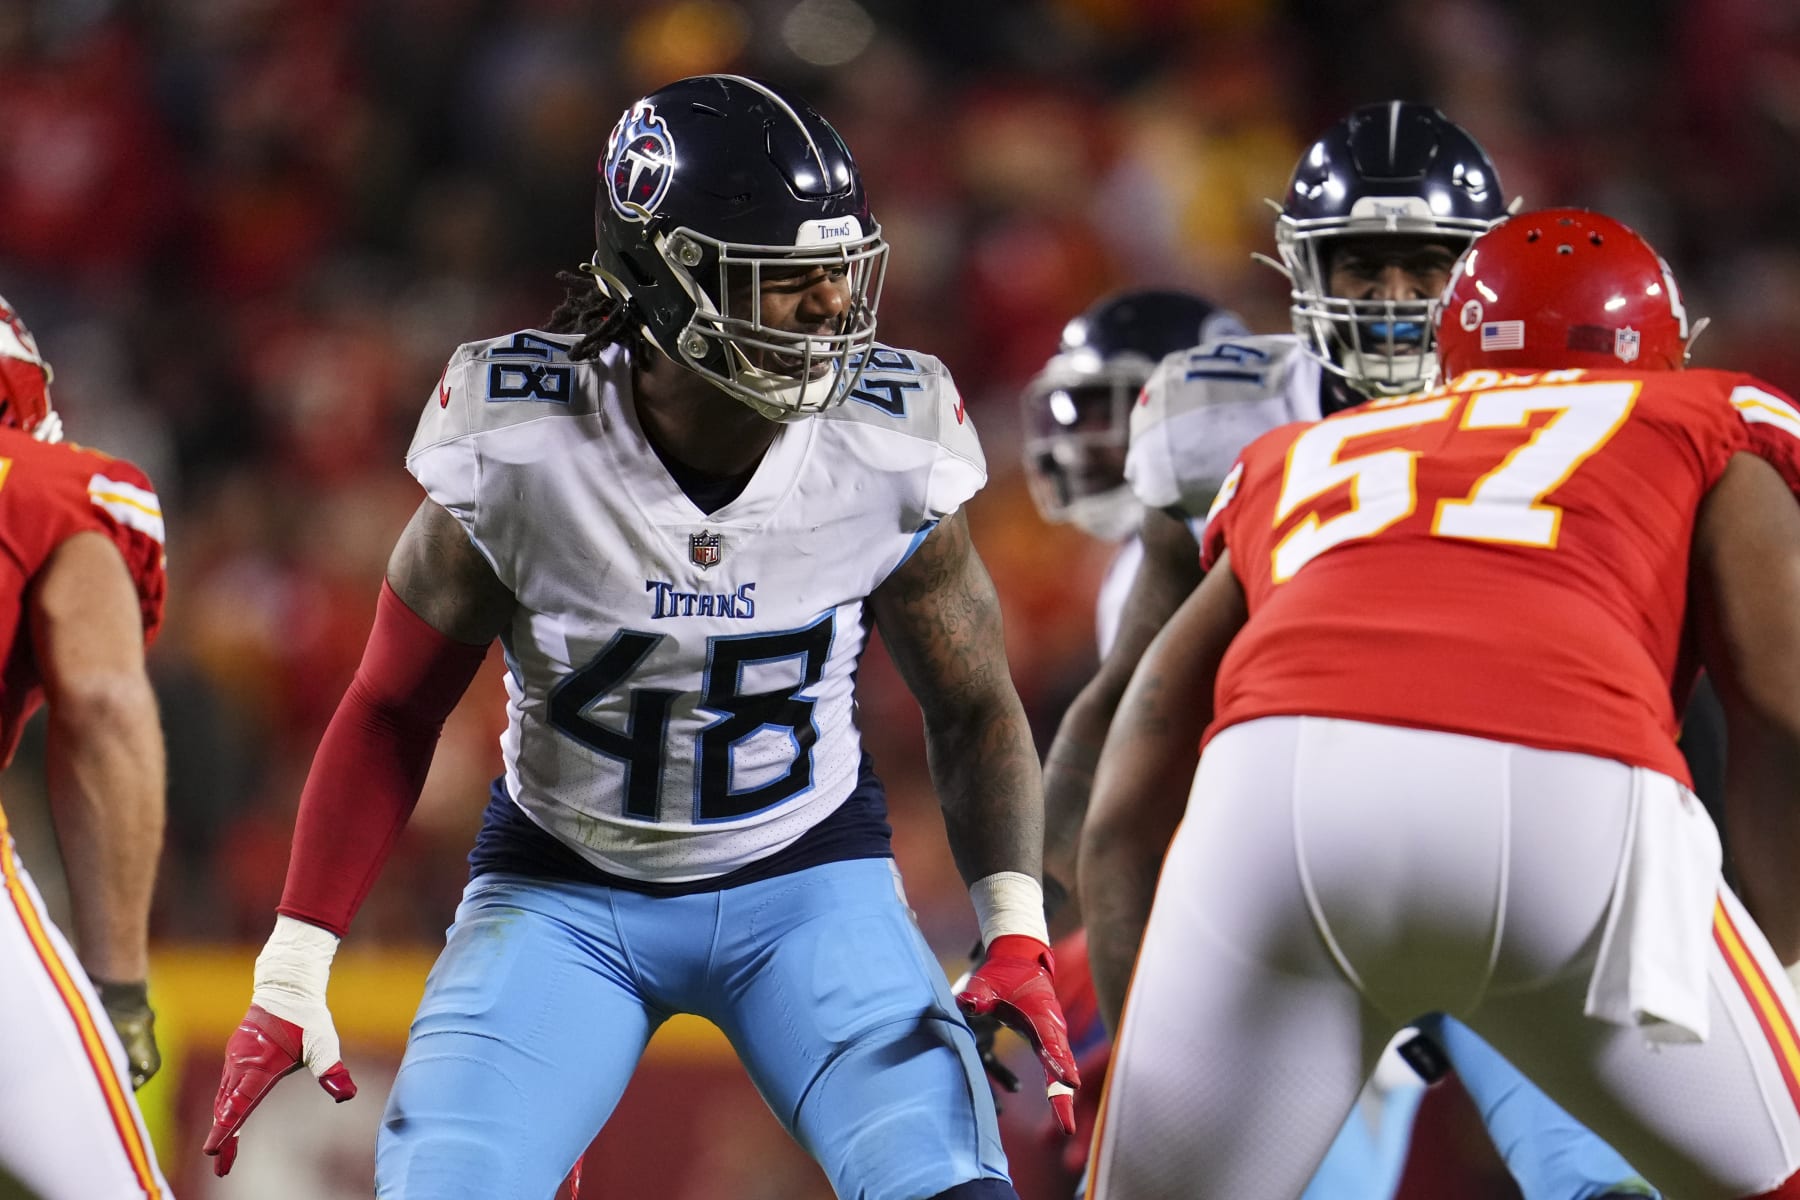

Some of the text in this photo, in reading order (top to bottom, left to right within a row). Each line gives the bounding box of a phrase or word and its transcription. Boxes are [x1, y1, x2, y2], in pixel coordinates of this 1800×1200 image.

[486, 332, 575, 403] 48
[1271, 380, 1643, 584] 57
[546, 607, 836, 825] 48
